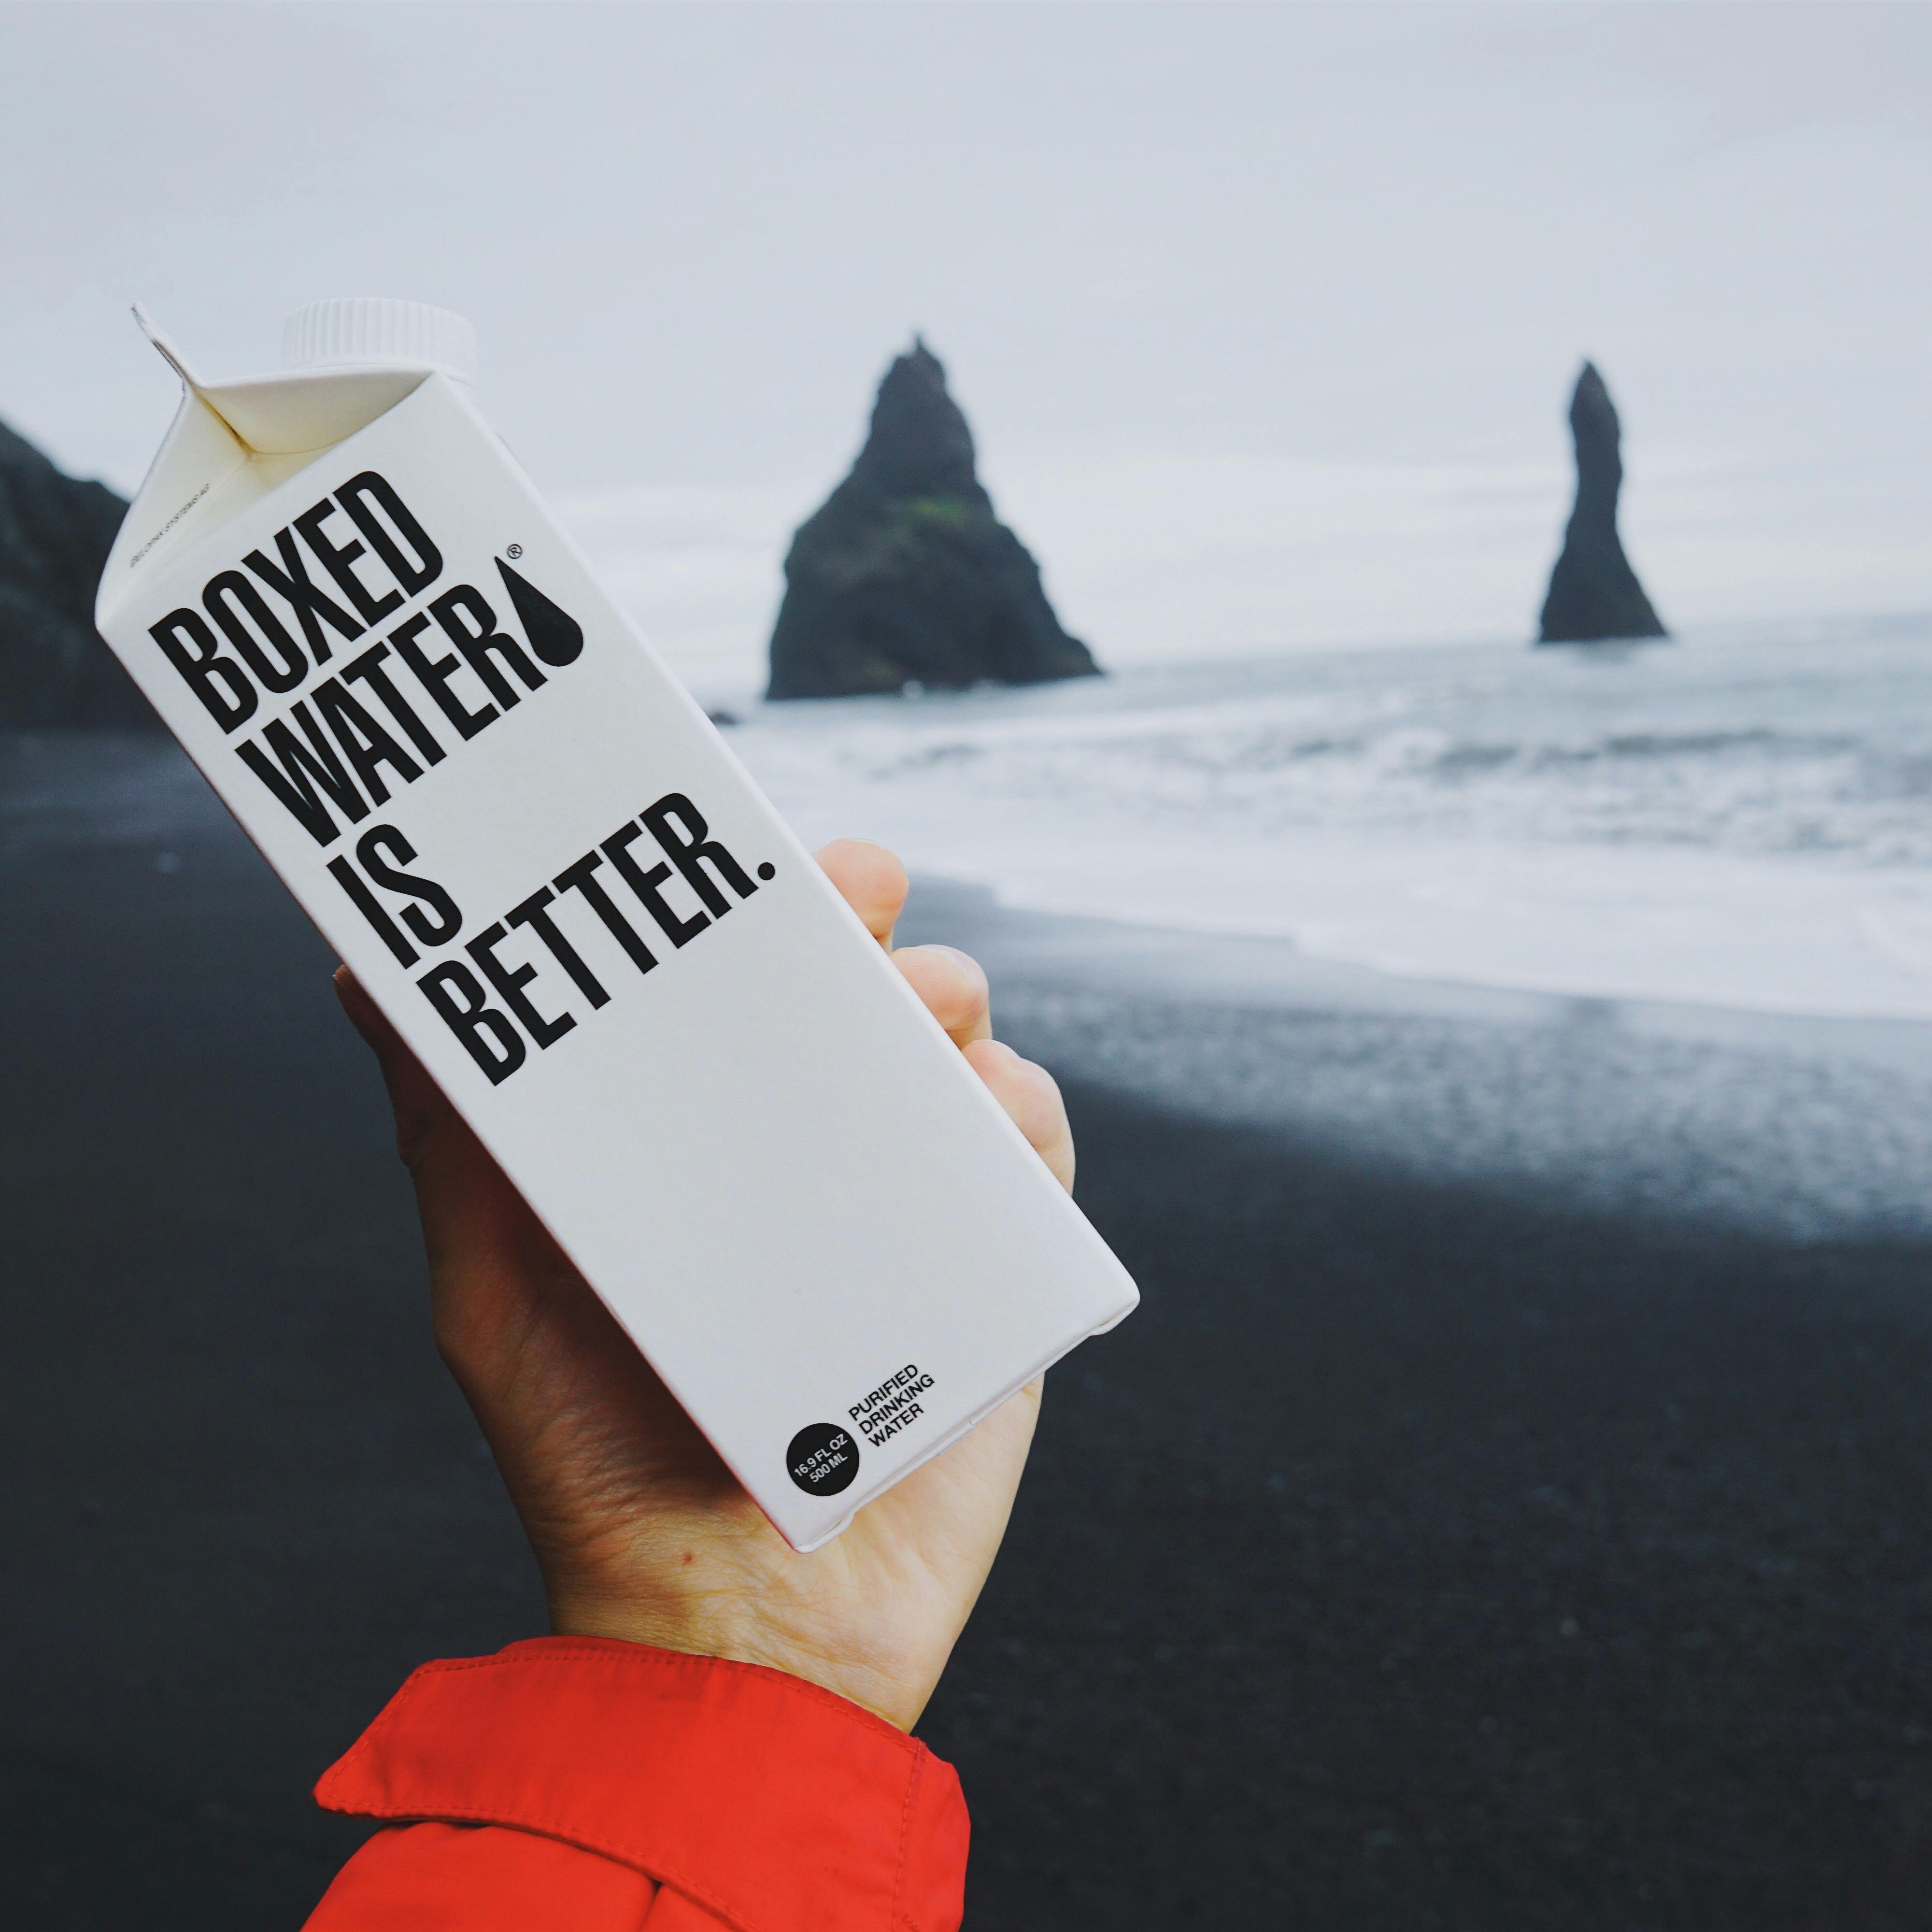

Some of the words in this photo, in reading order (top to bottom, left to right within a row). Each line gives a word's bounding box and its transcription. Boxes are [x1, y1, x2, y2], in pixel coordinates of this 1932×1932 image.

[147, 471, 443, 735] BOXED
[234, 584, 548, 847] WATER
[326, 824, 463, 970] IS
[415, 793, 775, 1087] BETTER.
[848, 1364, 918, 1421] PURIFIED
[858, 1374, 935, 1434] DRINKING
[794, 1458, 817, 1476] 16.9
[814, 1448, 832, 1462] FL
[829, 1433, 848, 1450] OZ
[868, 1403, 924, 1447] WATER
[809, 1463, 831, 1482] 500
[828, 1453, 849, 1468] ML
